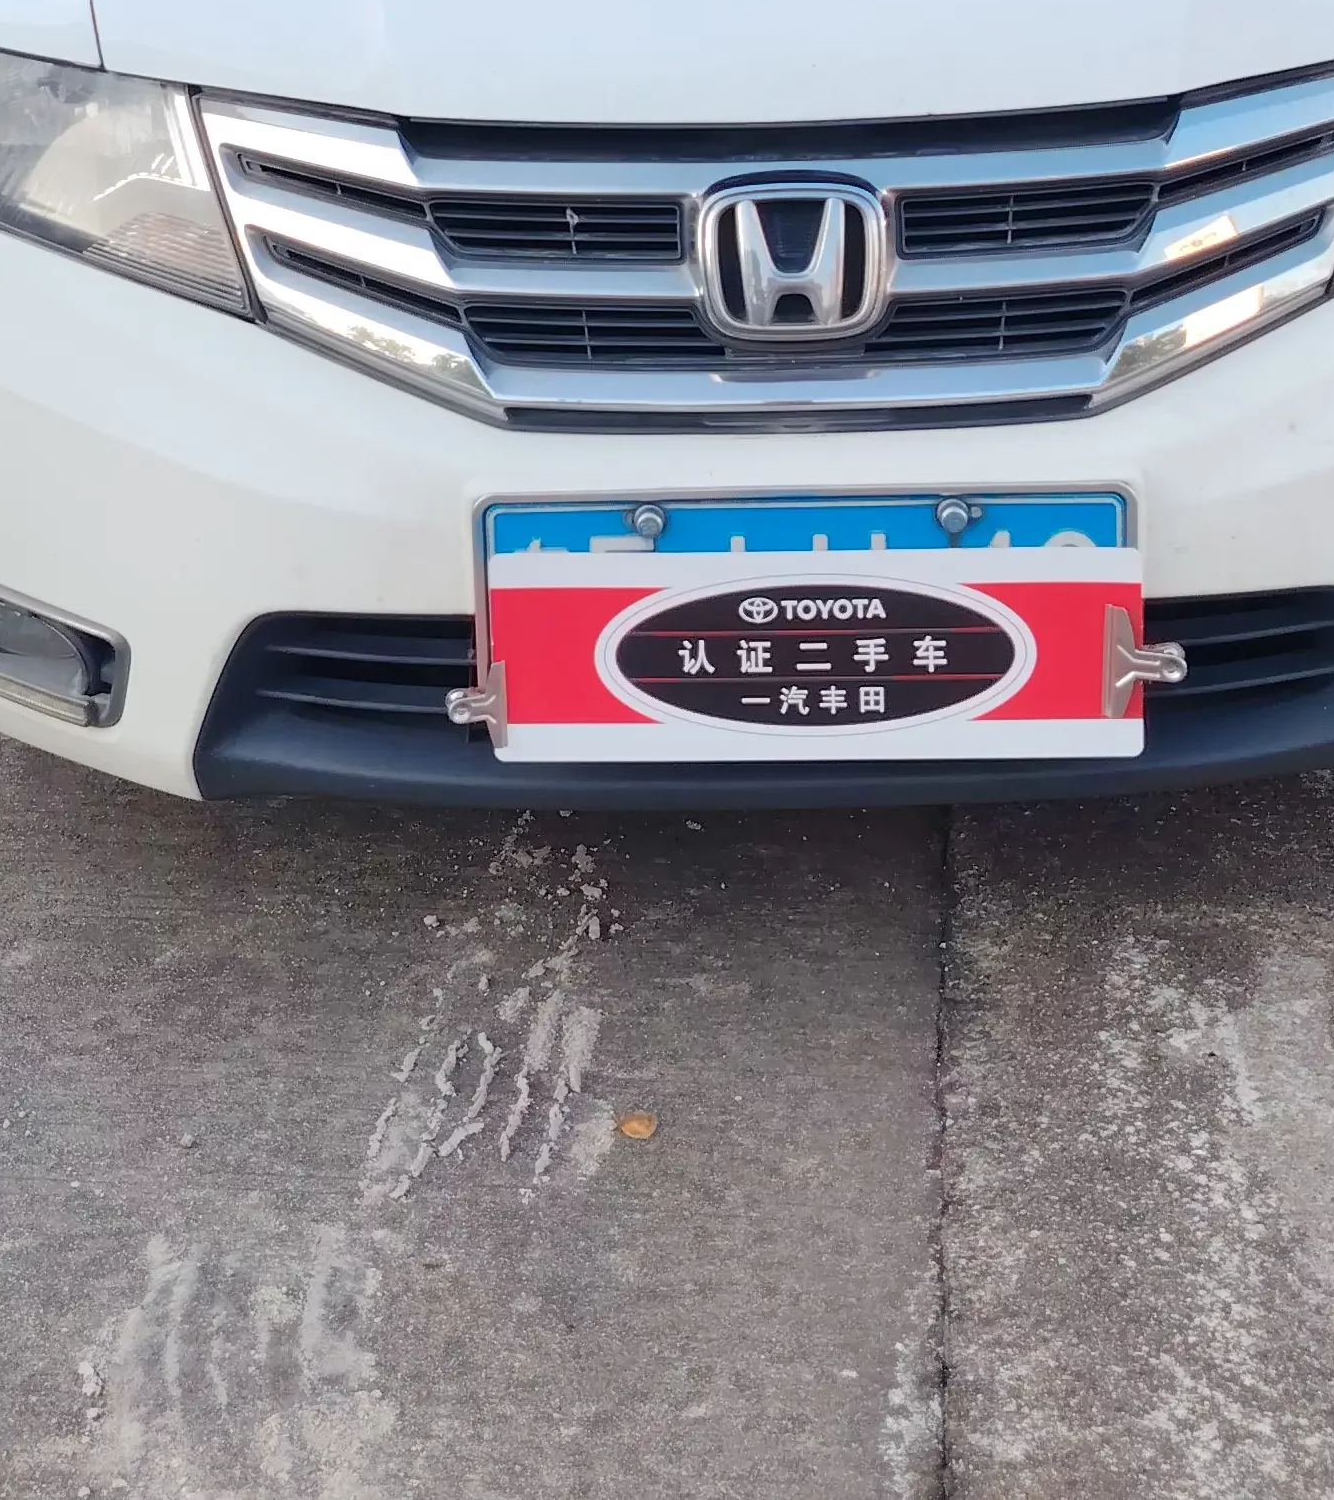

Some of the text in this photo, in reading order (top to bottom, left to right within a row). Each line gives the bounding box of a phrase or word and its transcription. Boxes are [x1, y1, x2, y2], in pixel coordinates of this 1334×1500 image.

[780, 598, 887, 622] TOYOTA
[678, 634, 950, 677] 认证二手车
[740, 686, 888, 716] 一汽丰田
